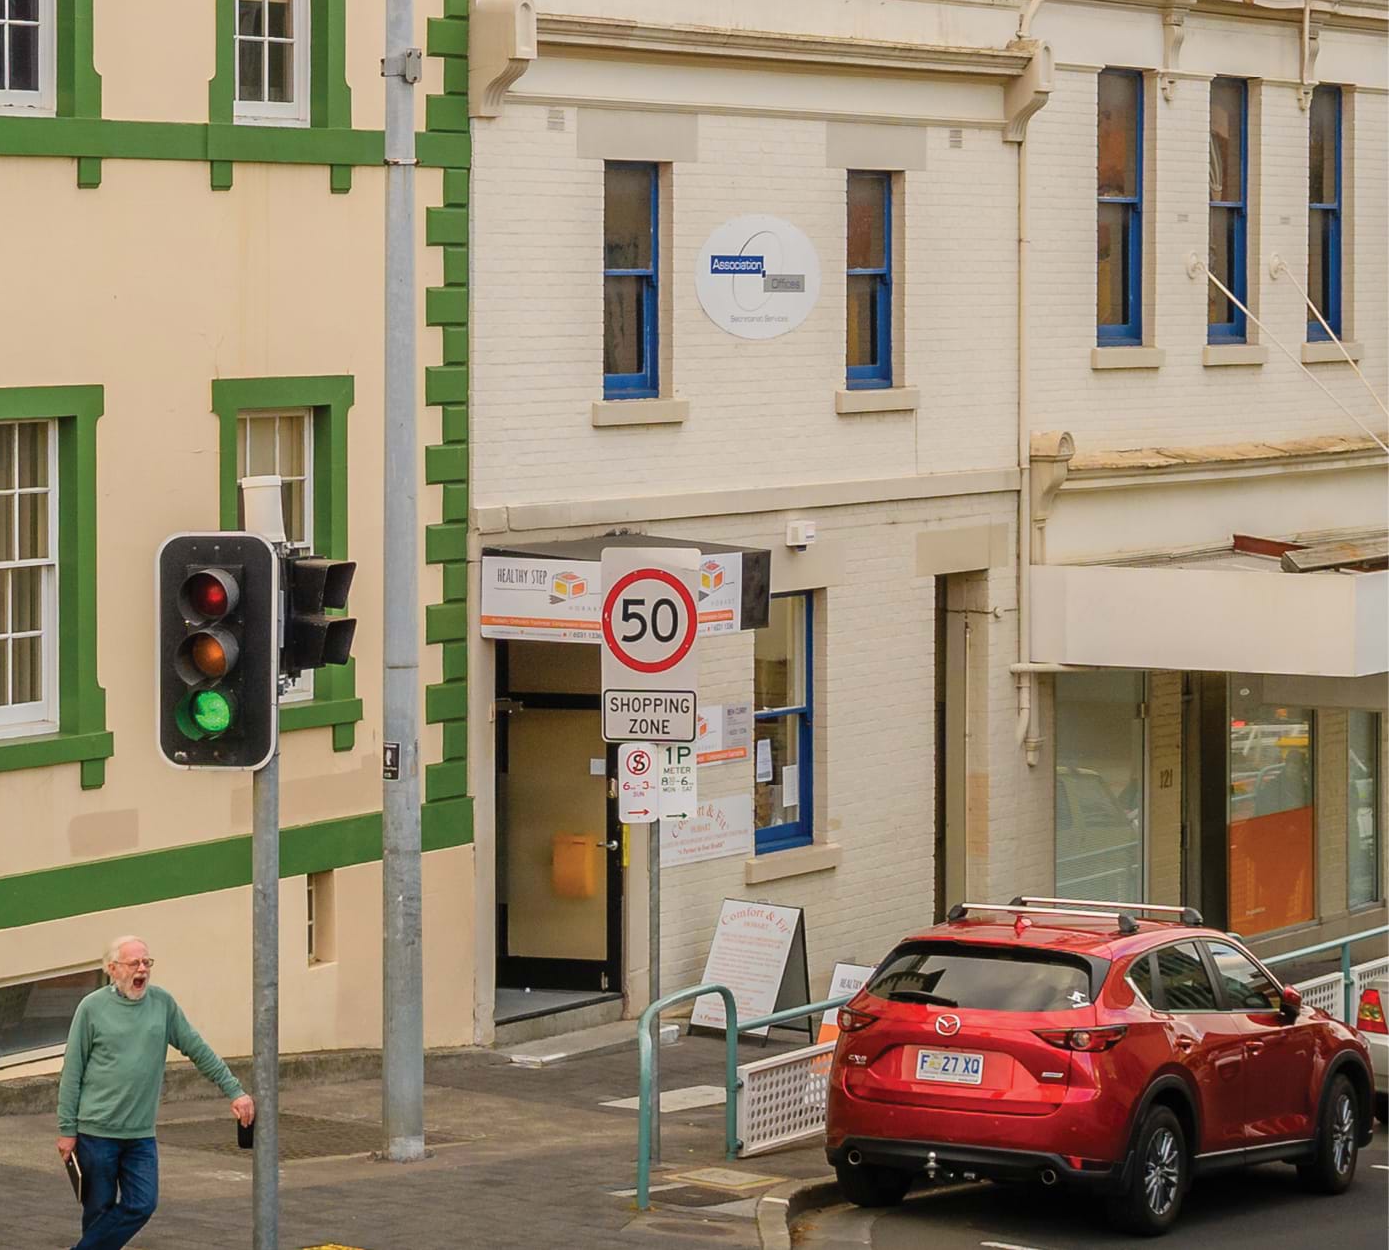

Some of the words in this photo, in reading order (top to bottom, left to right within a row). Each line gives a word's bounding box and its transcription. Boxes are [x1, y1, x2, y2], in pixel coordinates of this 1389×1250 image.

[712, 258, 763, 270] Association
[771, 278, 801, 290] Offices
[497, 568, 528, 584] HEALTHY
[531, 569, 548, 585] STEP
[621, 598, 679, 643] 50
[610, 696, 691, 714] SHOPPING
[629, 718, 671, 735] ZONE
[666, 746, 691, 765] 1P
[721, 906, 764, 926] Comfort
[765, 910, 775, 922] &
[941, 1056, 959, 1073] 27
